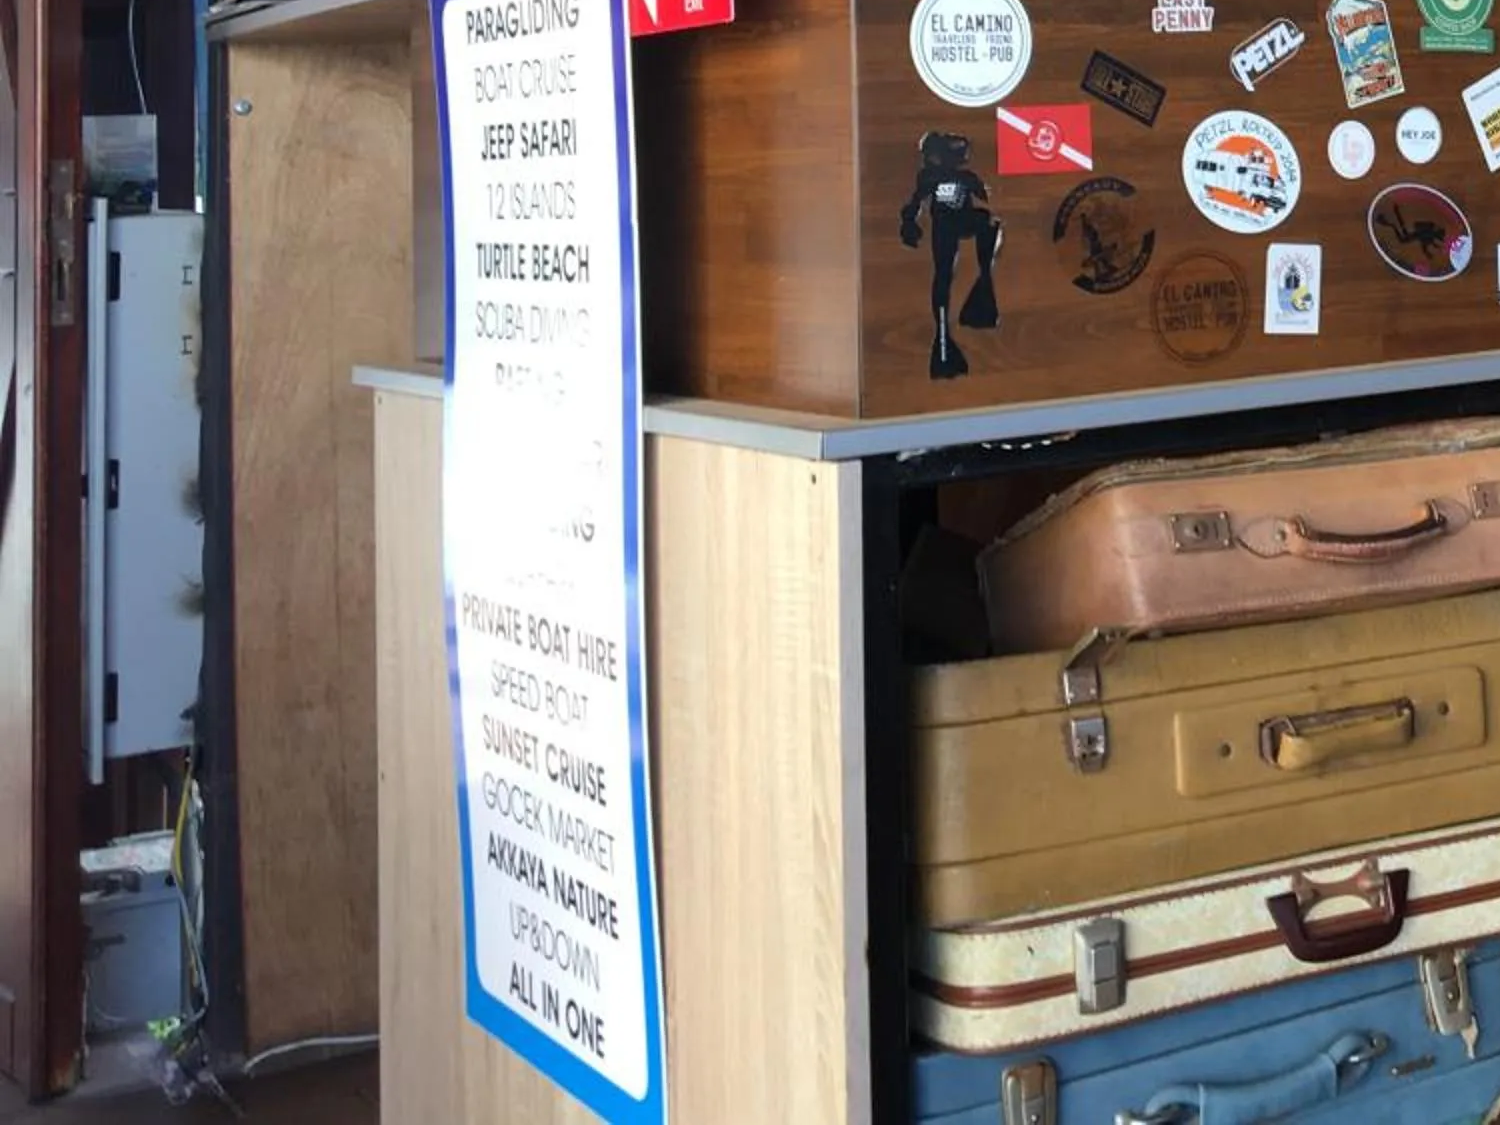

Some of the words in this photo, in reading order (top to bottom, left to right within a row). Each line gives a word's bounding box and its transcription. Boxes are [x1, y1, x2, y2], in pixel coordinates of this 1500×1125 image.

[931, 14, 948, 33] EL
[954, 14, 1013, 33] CAMINO
[1154, 8, 1213, 30] PENNY
[474, 62, 513, 103] BOAT
[519, 54, 577, 99] CRUISE
[931, 46, 979, 62] HOSTEL
[989, 46, 1014, 62] PUB
[1232, 22, 1305, 92] PETZL
[481, 123, 515, 161] JEEP
[520, 118, 577, 159] SAFARI
[1401, 129, 1417, 140] HEY
[1420, 129, 1436, 140] JOE
[487, 183, 505, 220] 12
[510, 180, 575, 220] ISLANDS
[475, 242, 526, 280] TURTLE
[532, 244, 590, 283] BEACH
[475, 300, 525, 339] SCUBA
[462, 592, 522, 646] PRIVATE
[528, 614, 570, 664] BOAT
[577, 630, 617, 682] HIRE
[491, 659, 541, 712] SPEED
[545, 680, 588, 726] BOAT
[482, 714, 539, 774] SUNSET
[546, 742, 607, 808] CRUISE
[482, 771, 543, 837] GOCEK
[548, 801, 615, 875] MARKET
[487, 830, 550, 899] AKKAYA
[553, 866, 619, 941] NATURE
[509, 902, 601, 992] UP&DOWN
[509, 960, 537, 1012] ALL
[542, 980, 560, 1028] IN
[565, 999, 605, 1060] ONE
